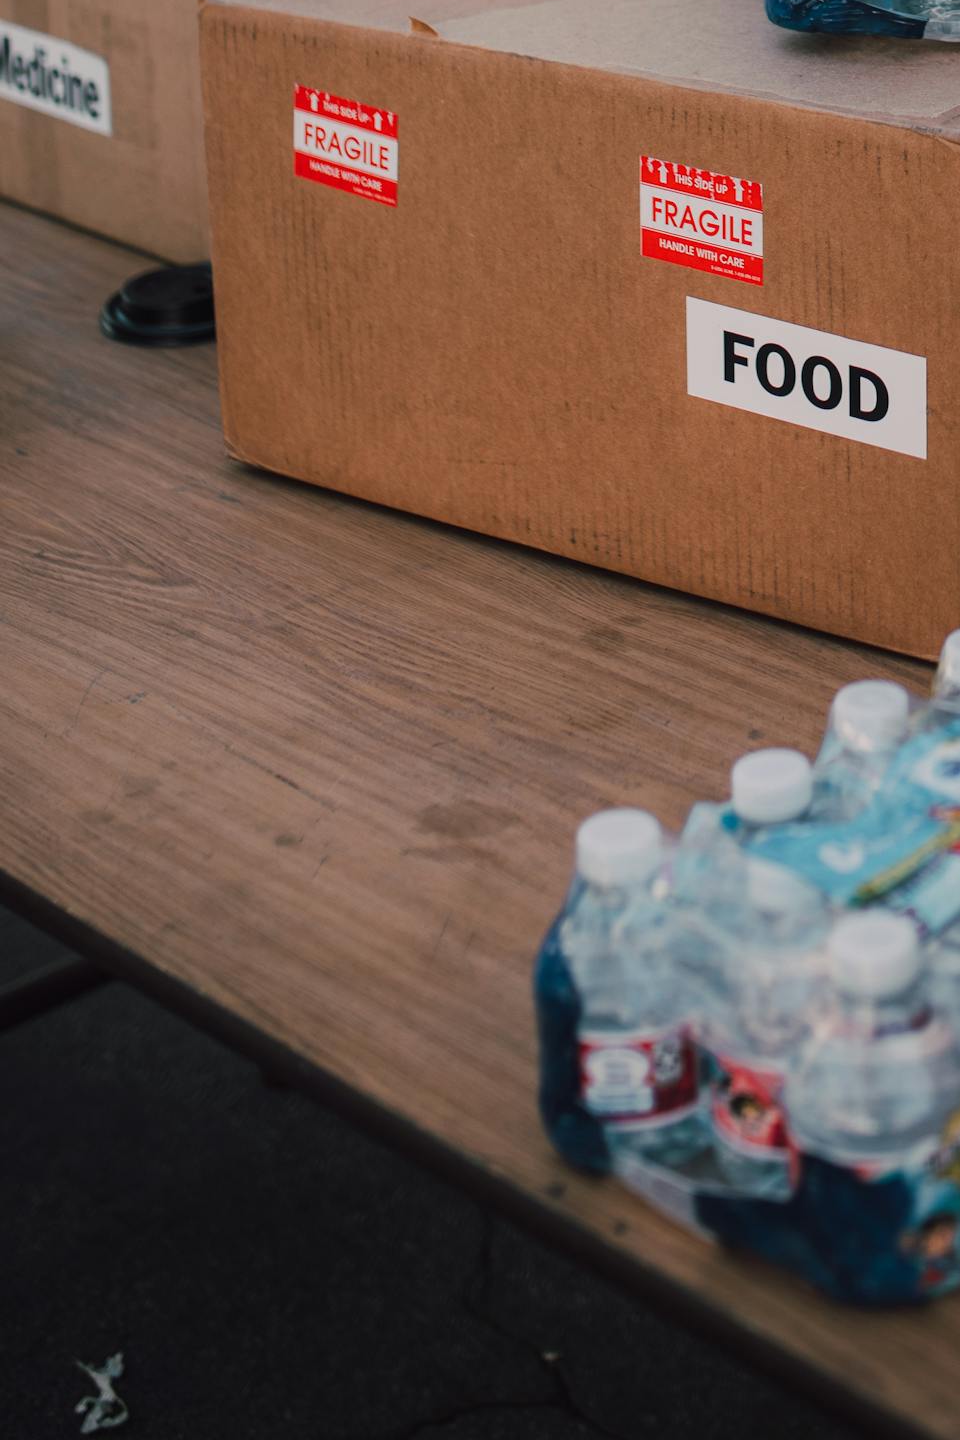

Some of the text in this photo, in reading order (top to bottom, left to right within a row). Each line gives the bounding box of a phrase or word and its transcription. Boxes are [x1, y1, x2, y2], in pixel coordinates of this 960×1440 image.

[303, 122, 390, 171] FRAGILE
[360, 174, 383, 192] CARE
[674, 172, 729, 195] THIS SIDE UP
[651, 196, 753, 247] FRAGILE
[658, 237, 745, 269] HANDLE WITH CARE
[723, 330, 889, 422] FOOD
